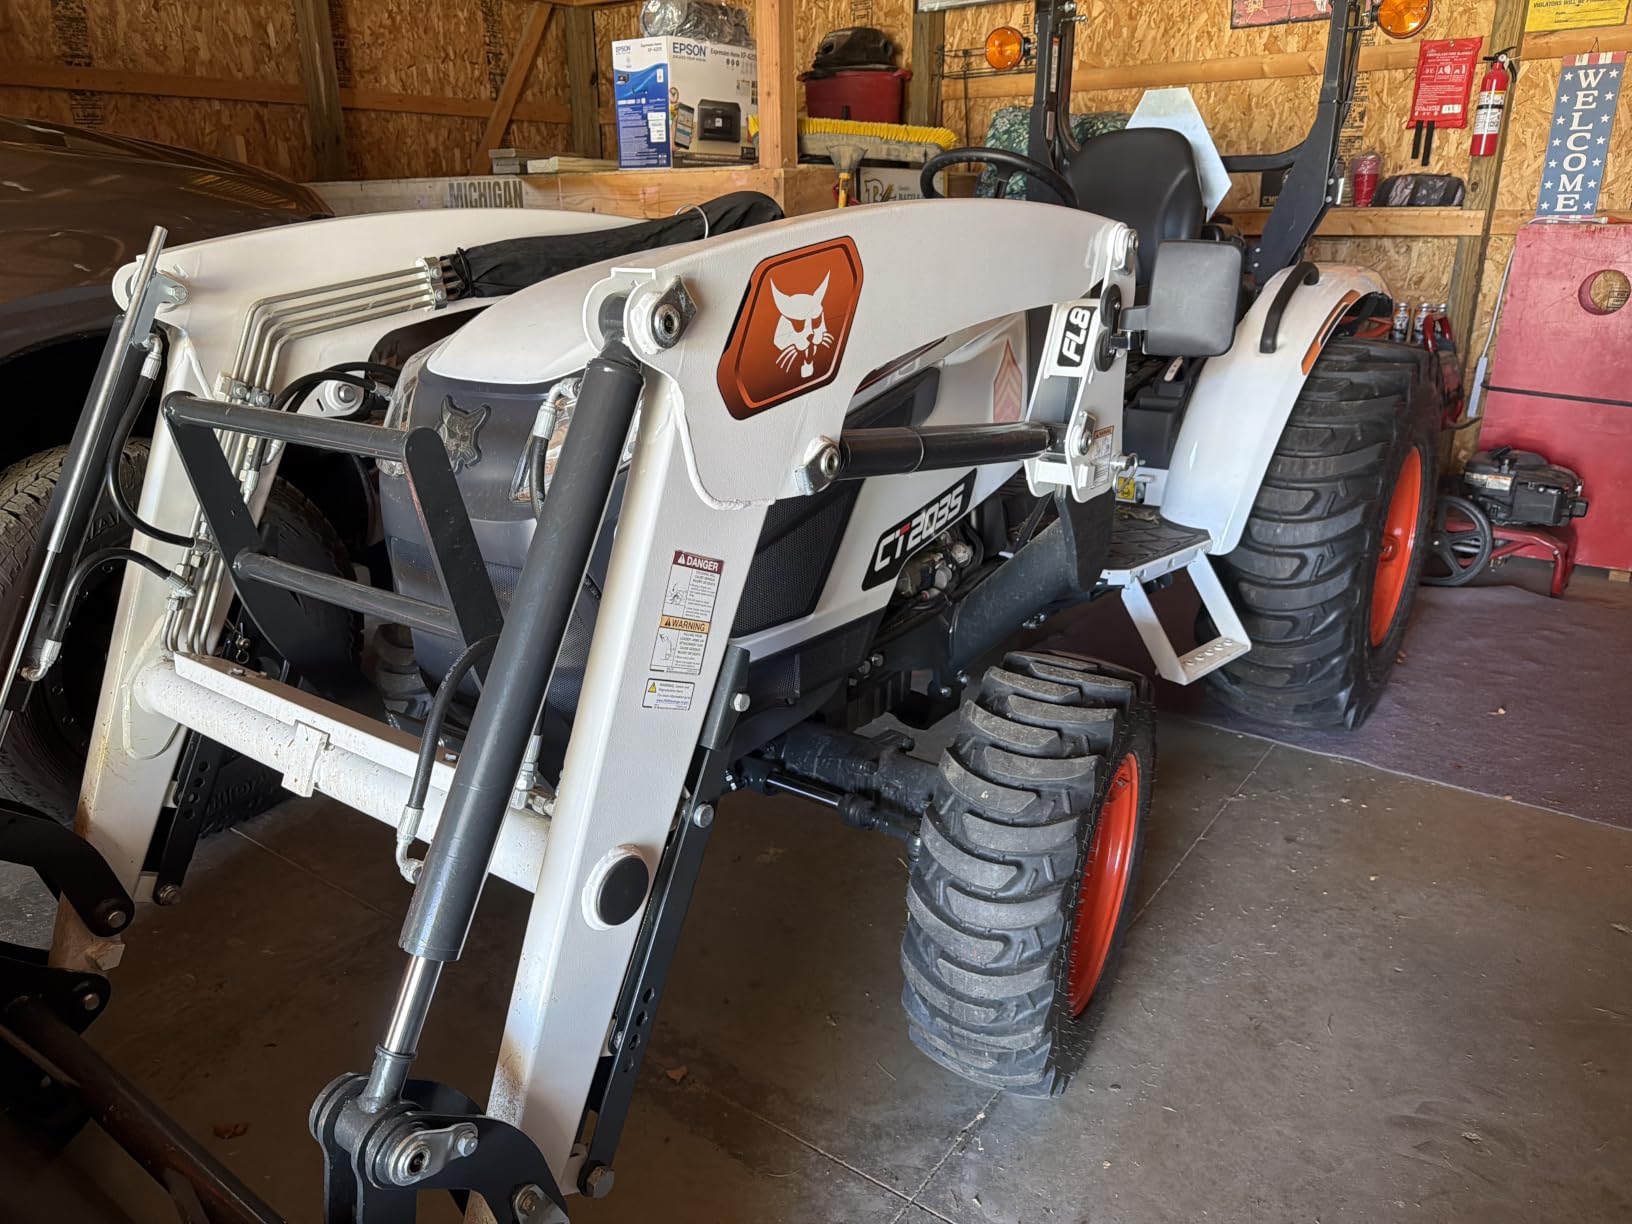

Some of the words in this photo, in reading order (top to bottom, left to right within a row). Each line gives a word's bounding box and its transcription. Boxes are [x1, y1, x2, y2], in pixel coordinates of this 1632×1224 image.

[615, 45, 631, 53] EPSON
[672, 42, 706, 57] EPSON
[1554, 68, 1607, 212] WELCOME
[447, 180, 524, 208] MICHIGAN
[1062, 307, 1091, 363] FL8
[874, 482, 965, 572] CT2035
[686, 555, 719, 572] DANGER
[671, 619, 705, 632] WARNING
